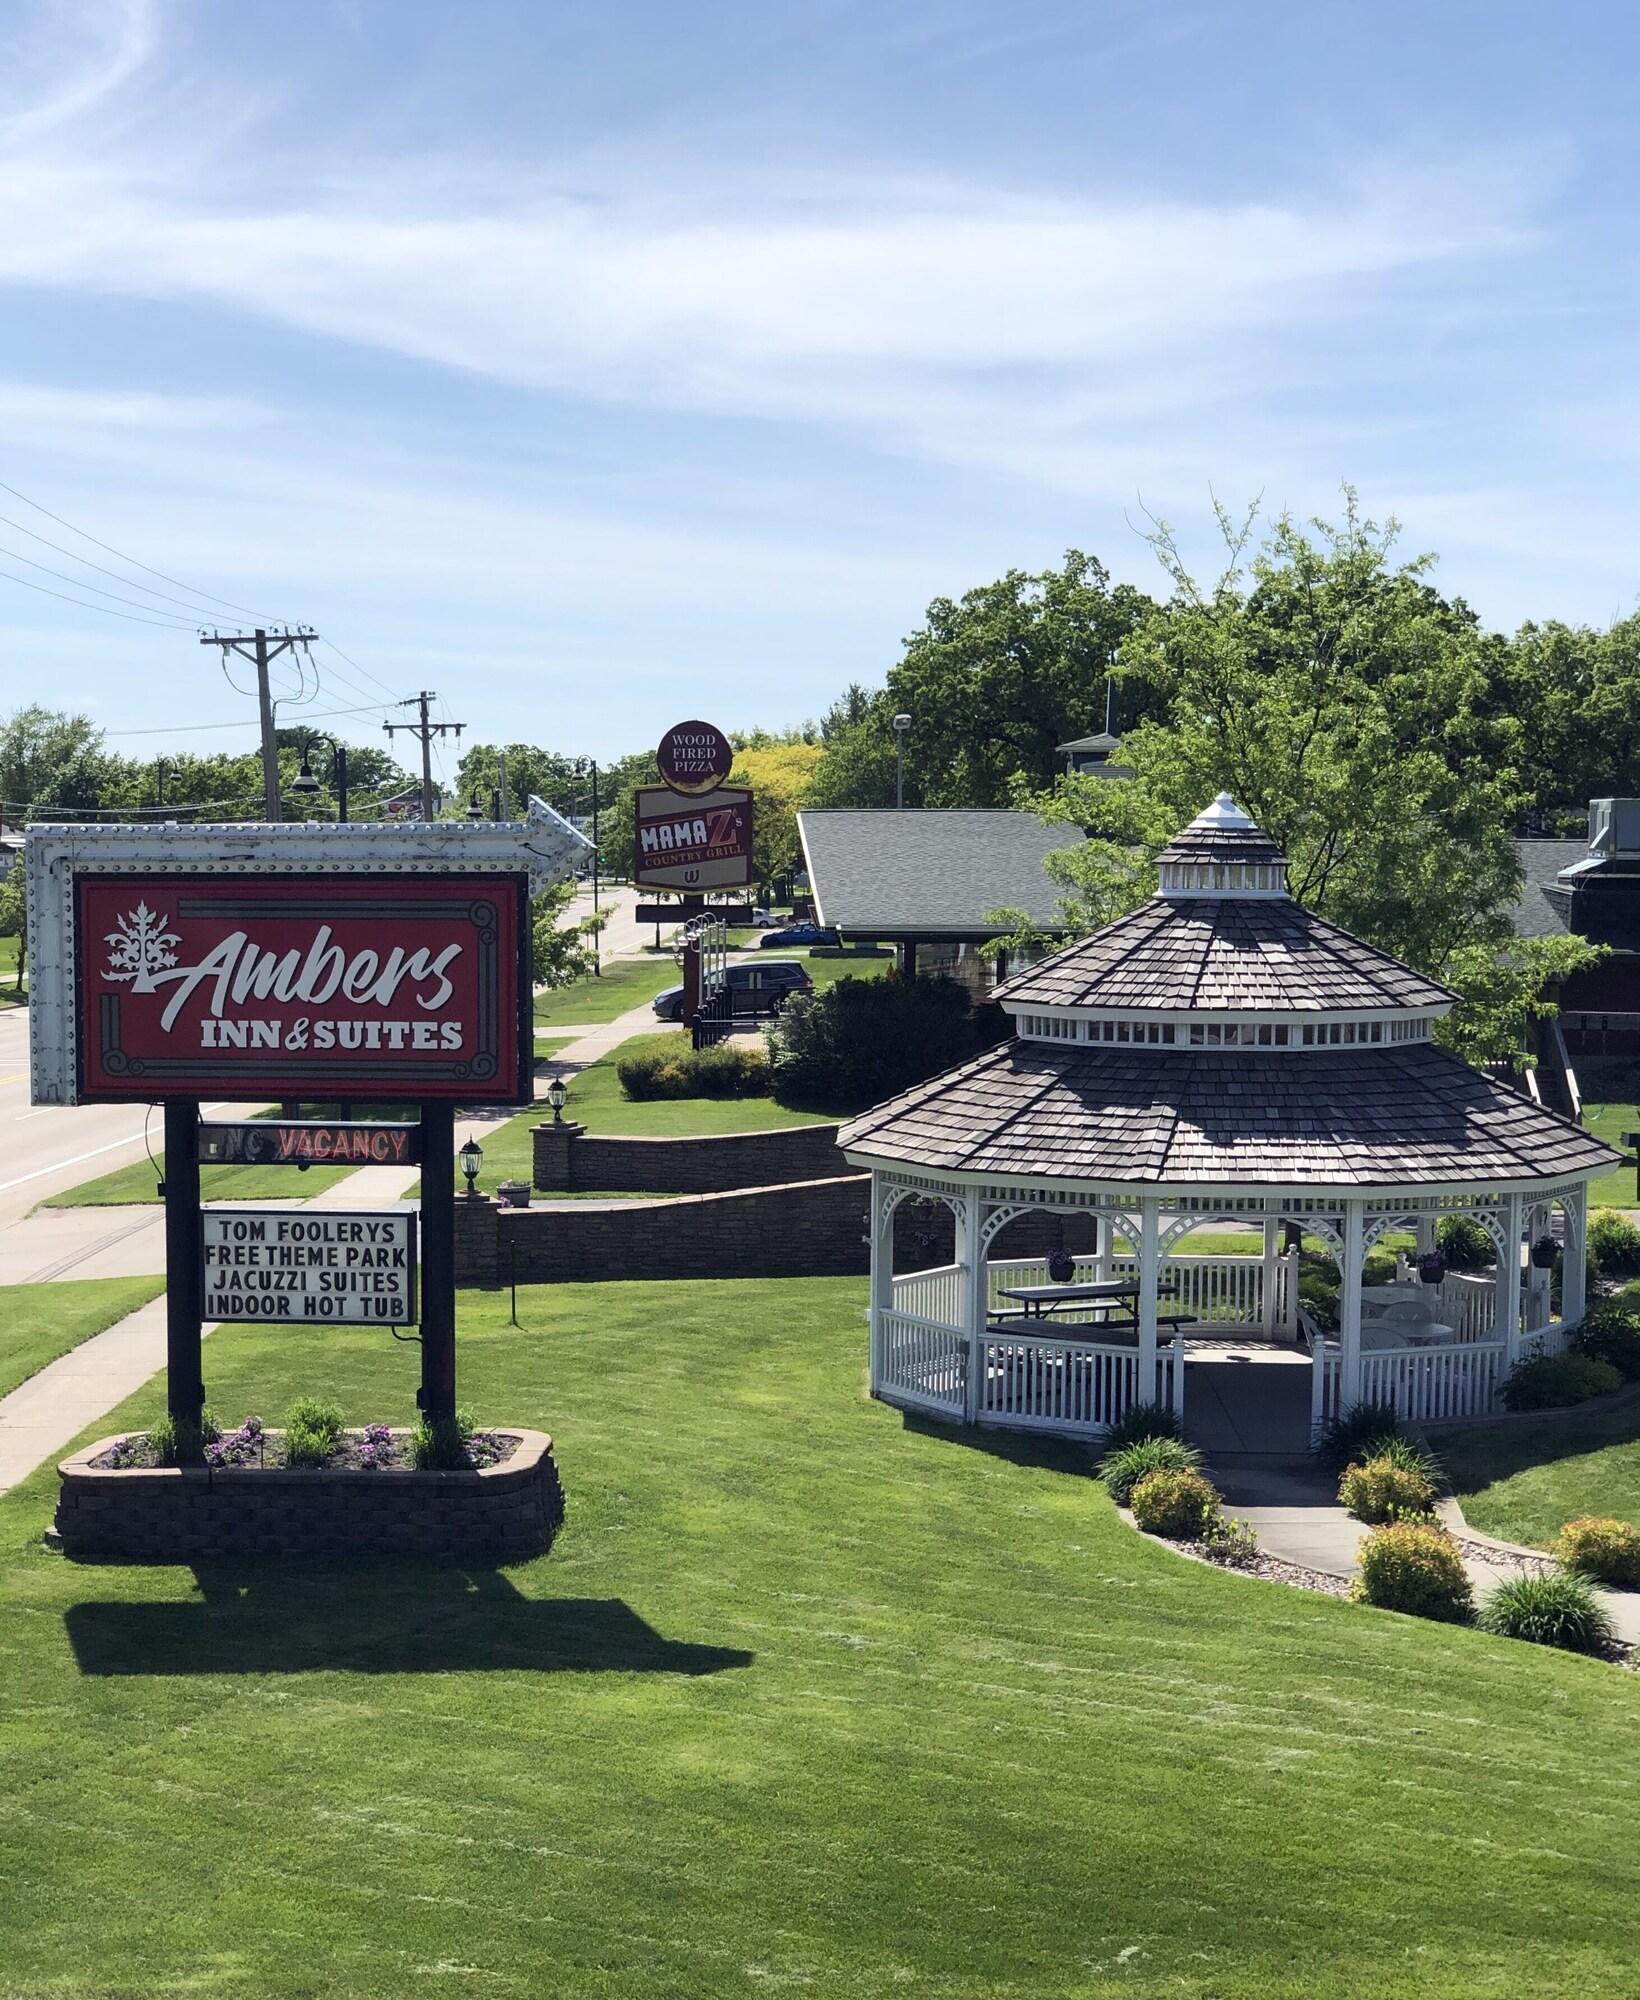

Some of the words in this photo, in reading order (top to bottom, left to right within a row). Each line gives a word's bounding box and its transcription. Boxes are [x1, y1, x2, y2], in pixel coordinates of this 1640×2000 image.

[672, 735, 716, 746] WOOD
[672, 748, 716, 759] FIRED
[674, 761, 715, 772] PIZZA
[645, 853, 702, 867] COUNTRY
[706, 845, 745, 858] GRILL
[160, 924, 463, 1032] Ambers
[278, 1128, 408, 1160] VACANCY
[219, 1221, 266, 1241] TOM
[277, 1221, 395, 1243] FOOLERYS
[204, 1245, 260, 1265] FREE
[265, 1246, 339, 1267] THEME
[346, 1248, 406, 1268] PARK
[213, 1270, 307, 1291] JACUZZI
[319, 1272, 400, 1292] SUITES
[207, 1295, 291, 1315] INDOOR
[304, 1296, 347, 1316] HOT
[360, 1297, 404, 1317] TUB
